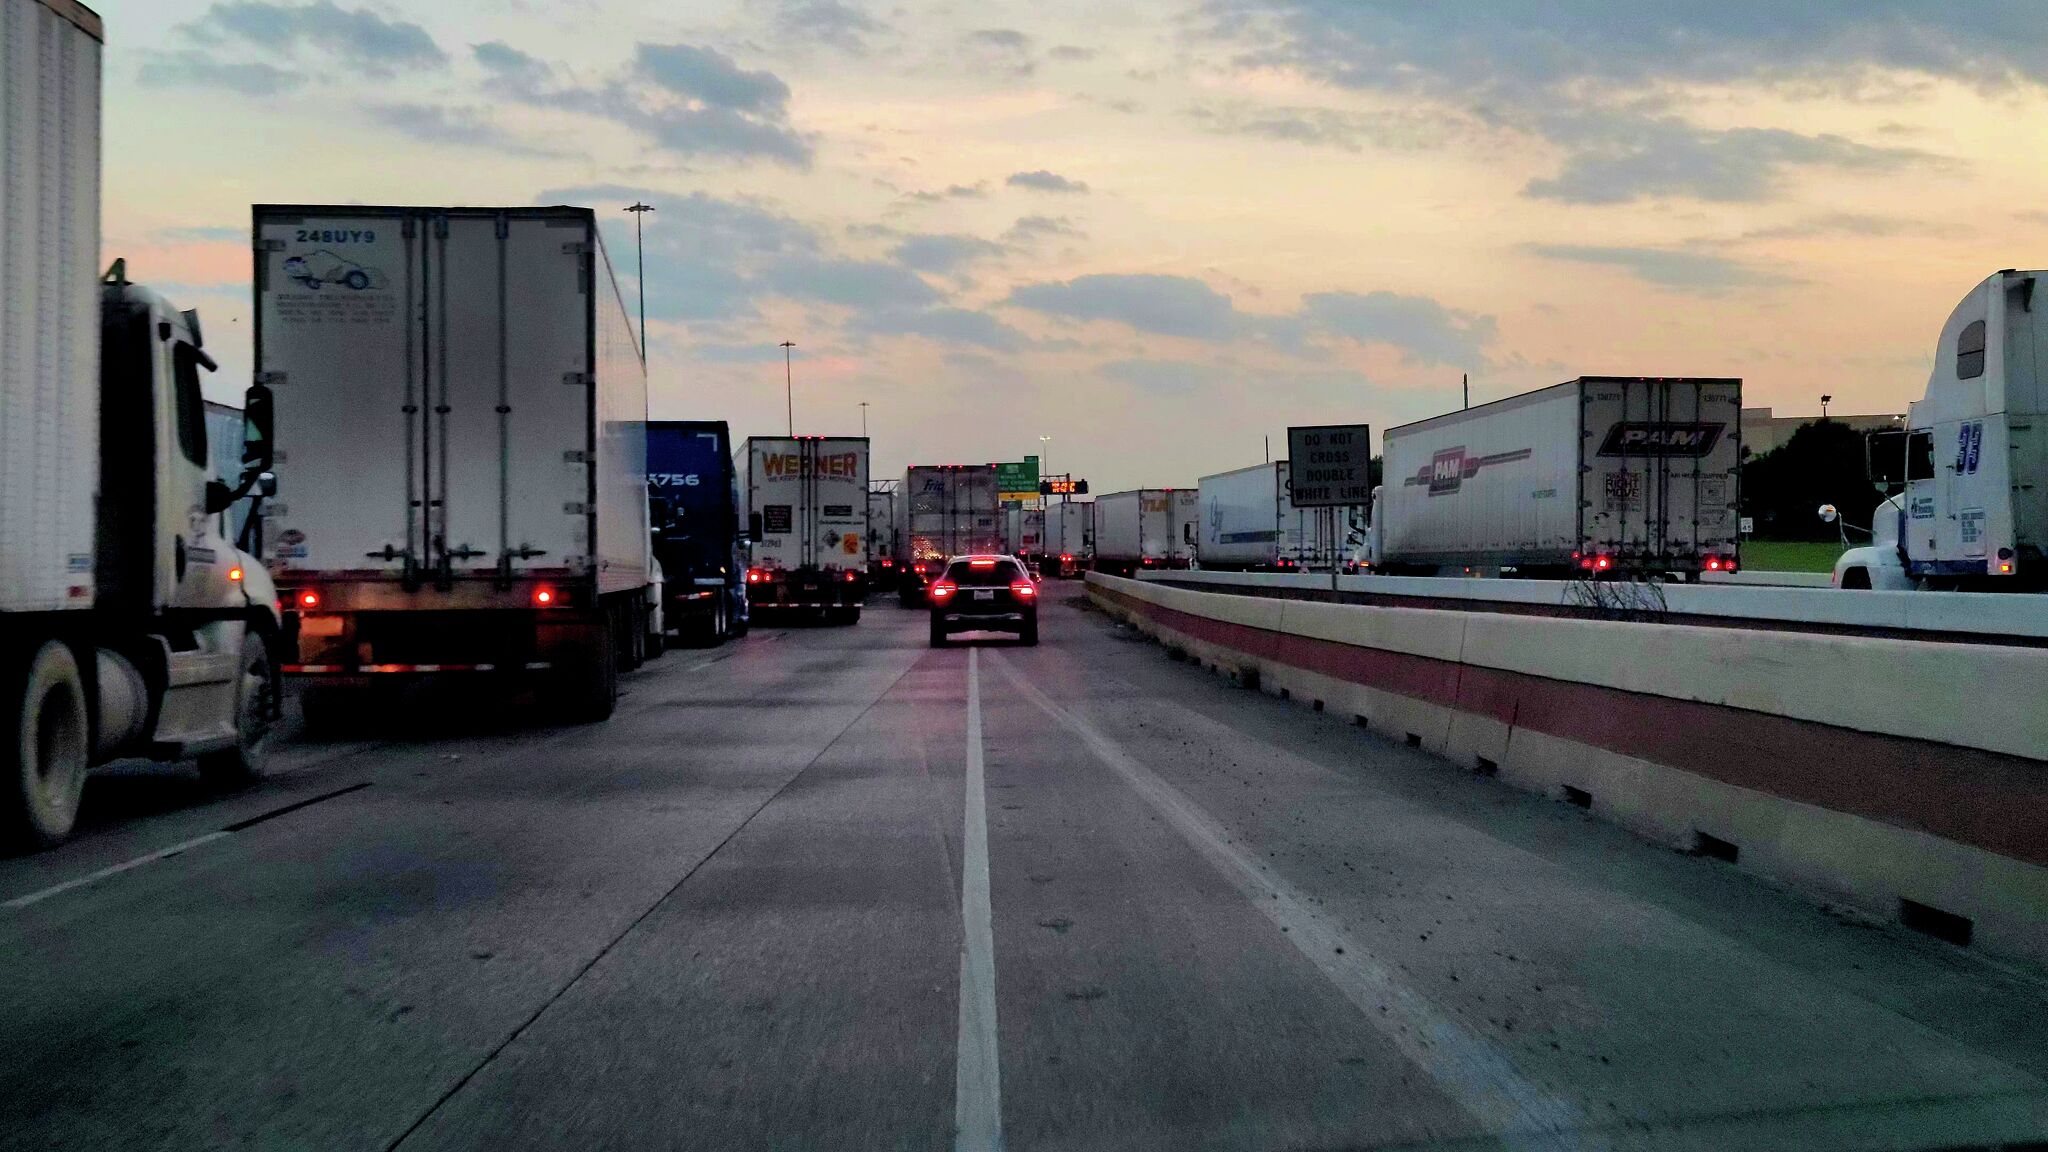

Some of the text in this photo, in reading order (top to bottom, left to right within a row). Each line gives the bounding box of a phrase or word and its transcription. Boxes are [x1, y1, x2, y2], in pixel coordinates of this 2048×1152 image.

[1304, 432, 1353, 446] DO NOT
[1620, 430, 1706, 445] PAM
[1310, 451, 1350, 463] CROSS
[762, 452, 858, 477] WERNER
[1434, 458, 1460, 480] PAM
[1306, 468, 1355, 481] DOUBLE
[1606, 479, 1638, 488] RIGHT
[1294, 487, 1330, 500] WHITE
[1340, 486, 1368, 498] LINE
[1606, 488, 1639, 498] MOVE
